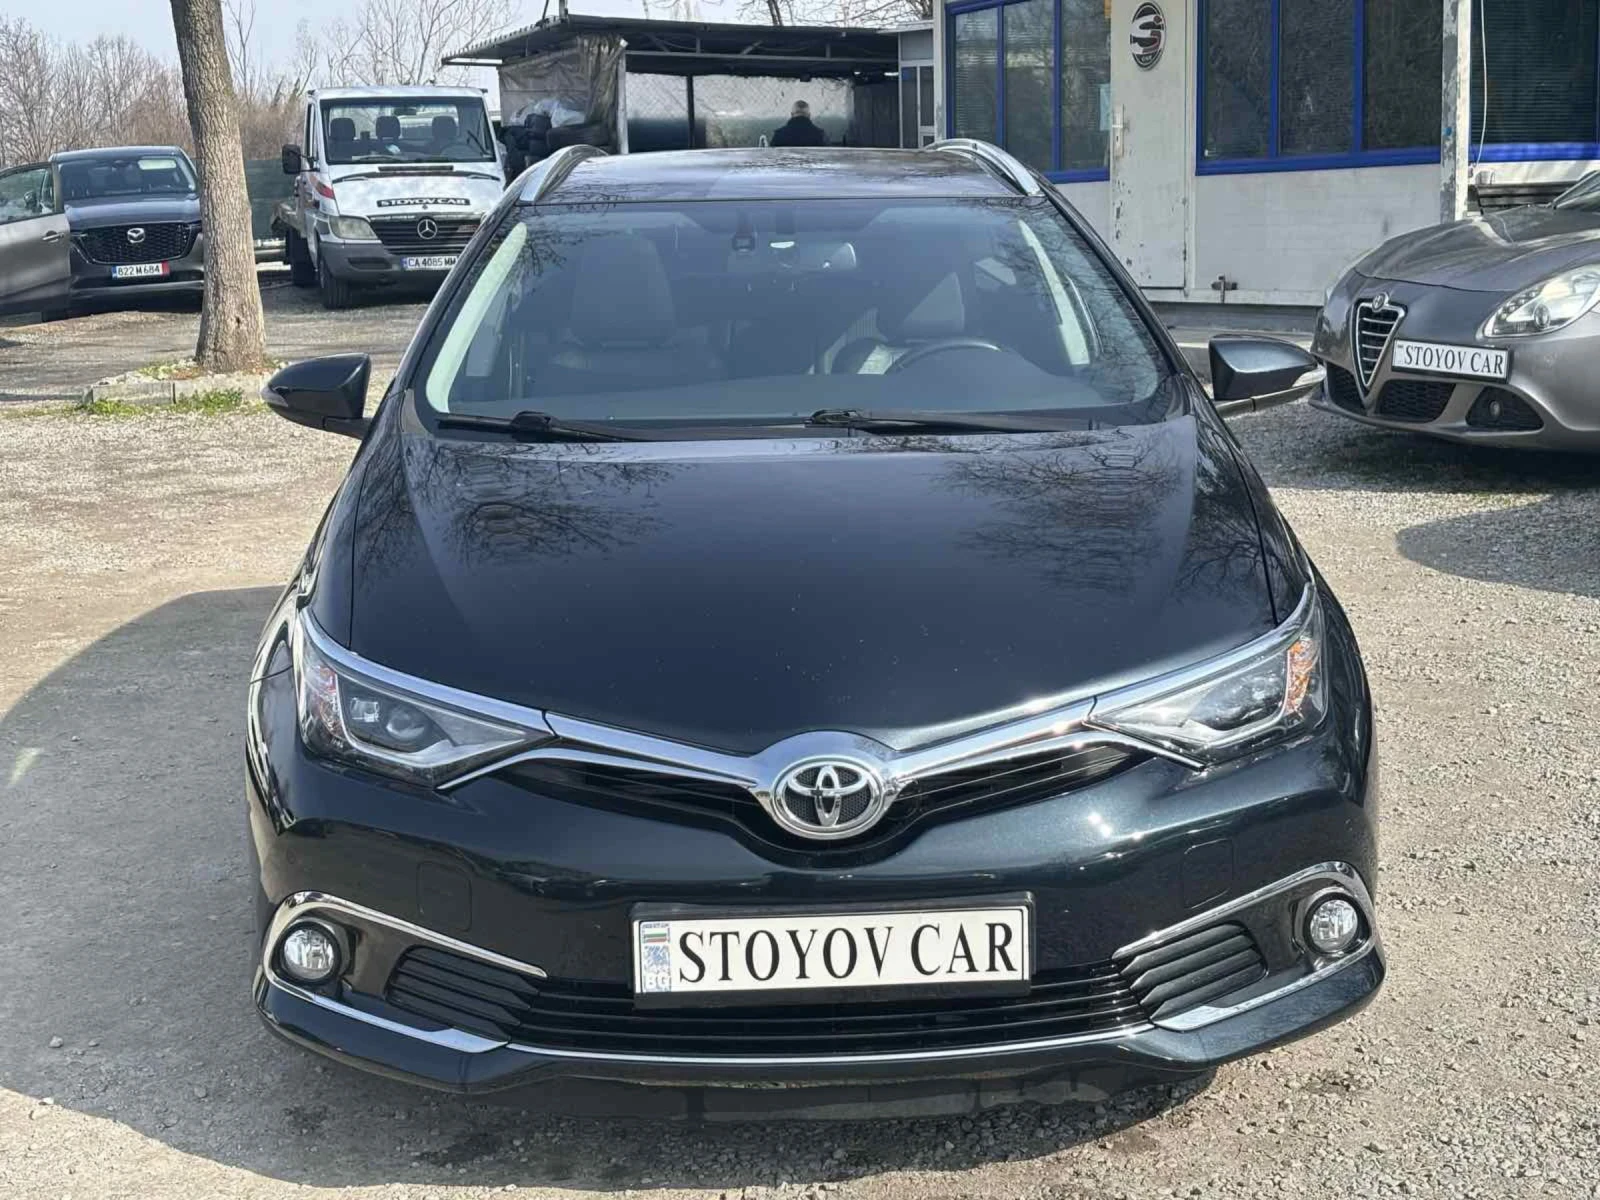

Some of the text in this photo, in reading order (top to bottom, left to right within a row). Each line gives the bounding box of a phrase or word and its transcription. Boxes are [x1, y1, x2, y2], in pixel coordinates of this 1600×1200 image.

[408, 258, 420, 267] CA
[1404, 345, 1504, 375] STOYOV CAR
[679, 922, 1018, 984] STOYOV CAR
